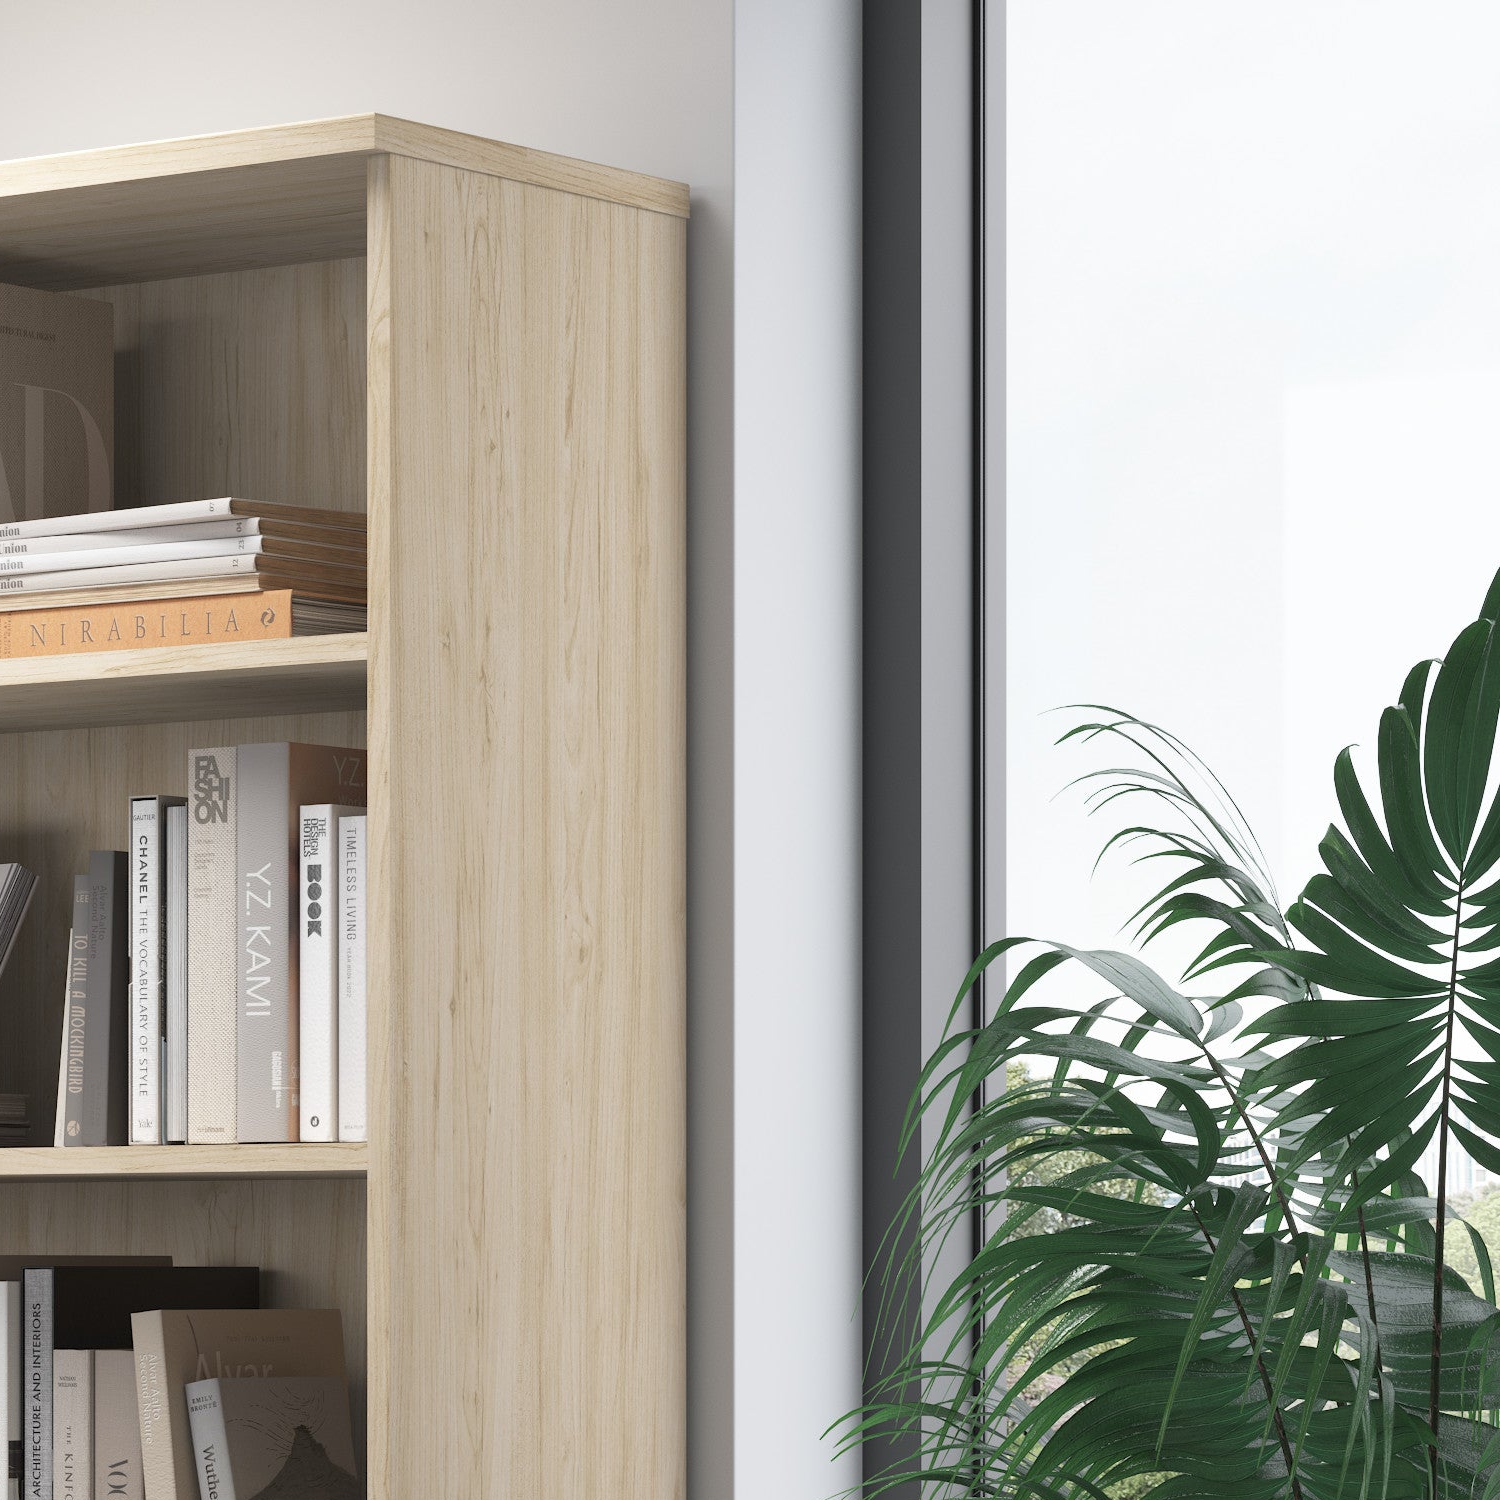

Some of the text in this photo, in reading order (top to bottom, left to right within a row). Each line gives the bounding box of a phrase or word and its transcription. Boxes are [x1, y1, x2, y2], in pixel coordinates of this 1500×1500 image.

[30, 608, 242, 648] NIRABILIA
[302, 818, 311, 858] HOTELS
[310, 817, 319, 856] DESIGN
[318, 817, 327, 837] THE
[306, 864, 323, 938] BOOK
[346, 828, 357, 941] TIMELESS LIVING
[74, 934, 88, 950] TO
[245, 862, 272, 1017] Y.Z. KAMI
[73, 957, 88, 983] KILL
[139, 835, 148, 1097] CHANEL THE VOCABULARY OF STYLE
[68, 1005, 86, 1094] MOCKINGBIRD
[32, 1303, 42, 1369] INTERIORS
[32, 1372, 42, 1402] AND
[191, 1394, 214, 1405] EMILY
[32, 1405, 42, 1498] ARCHITECTURE
